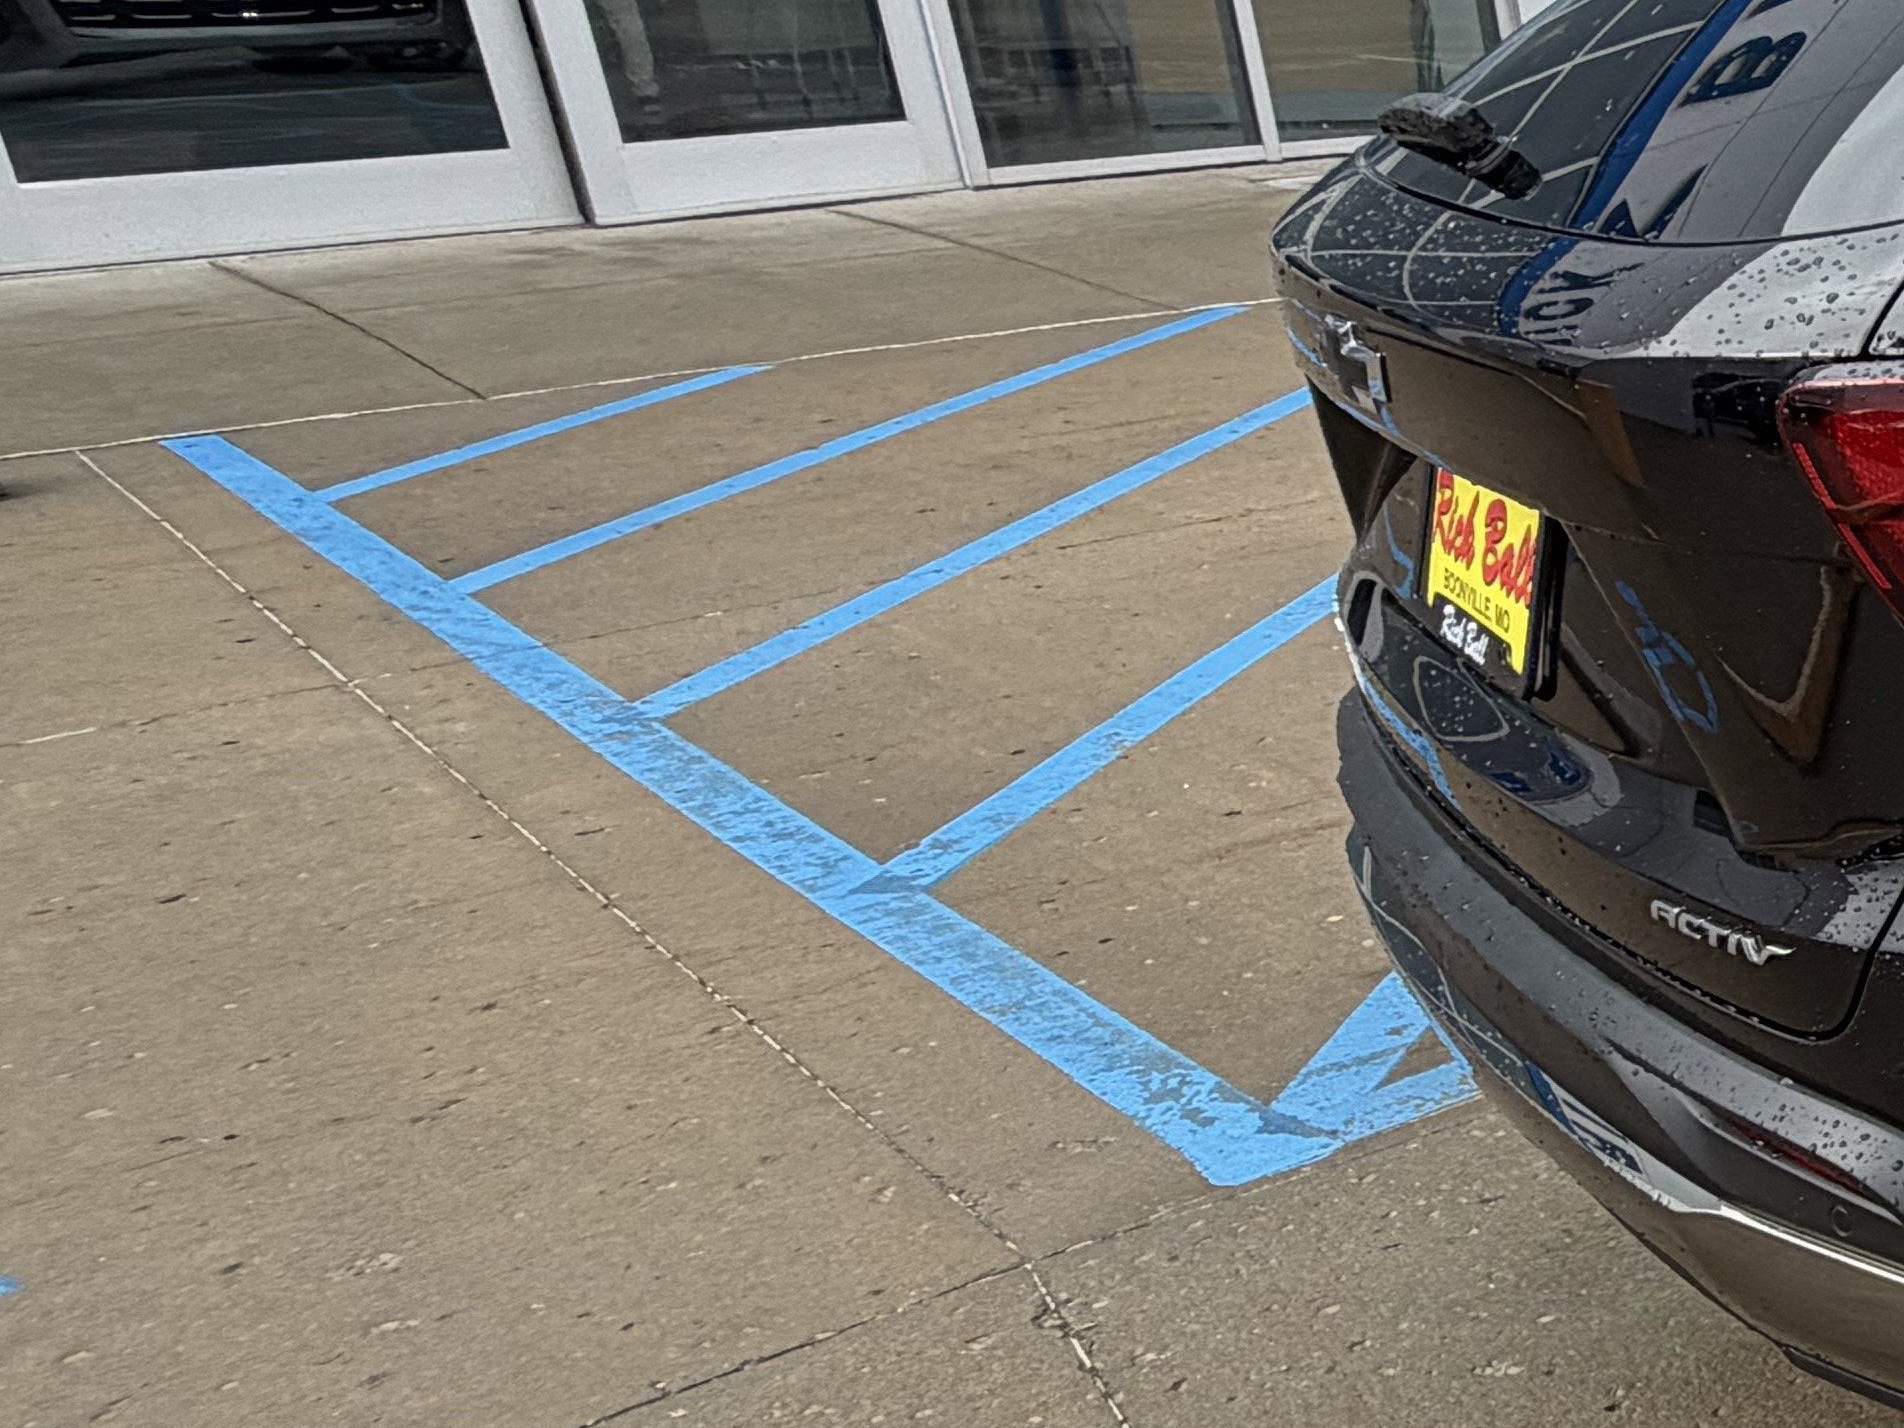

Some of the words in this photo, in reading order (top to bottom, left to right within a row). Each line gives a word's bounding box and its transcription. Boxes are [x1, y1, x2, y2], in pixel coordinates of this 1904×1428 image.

[1434, 471, 1481, 572] Rick
[1481, 498, 1538, 610] Ball
[1494, 603, 1510, 634] MO
[1650, 899, 1797, 966] ACTIV
